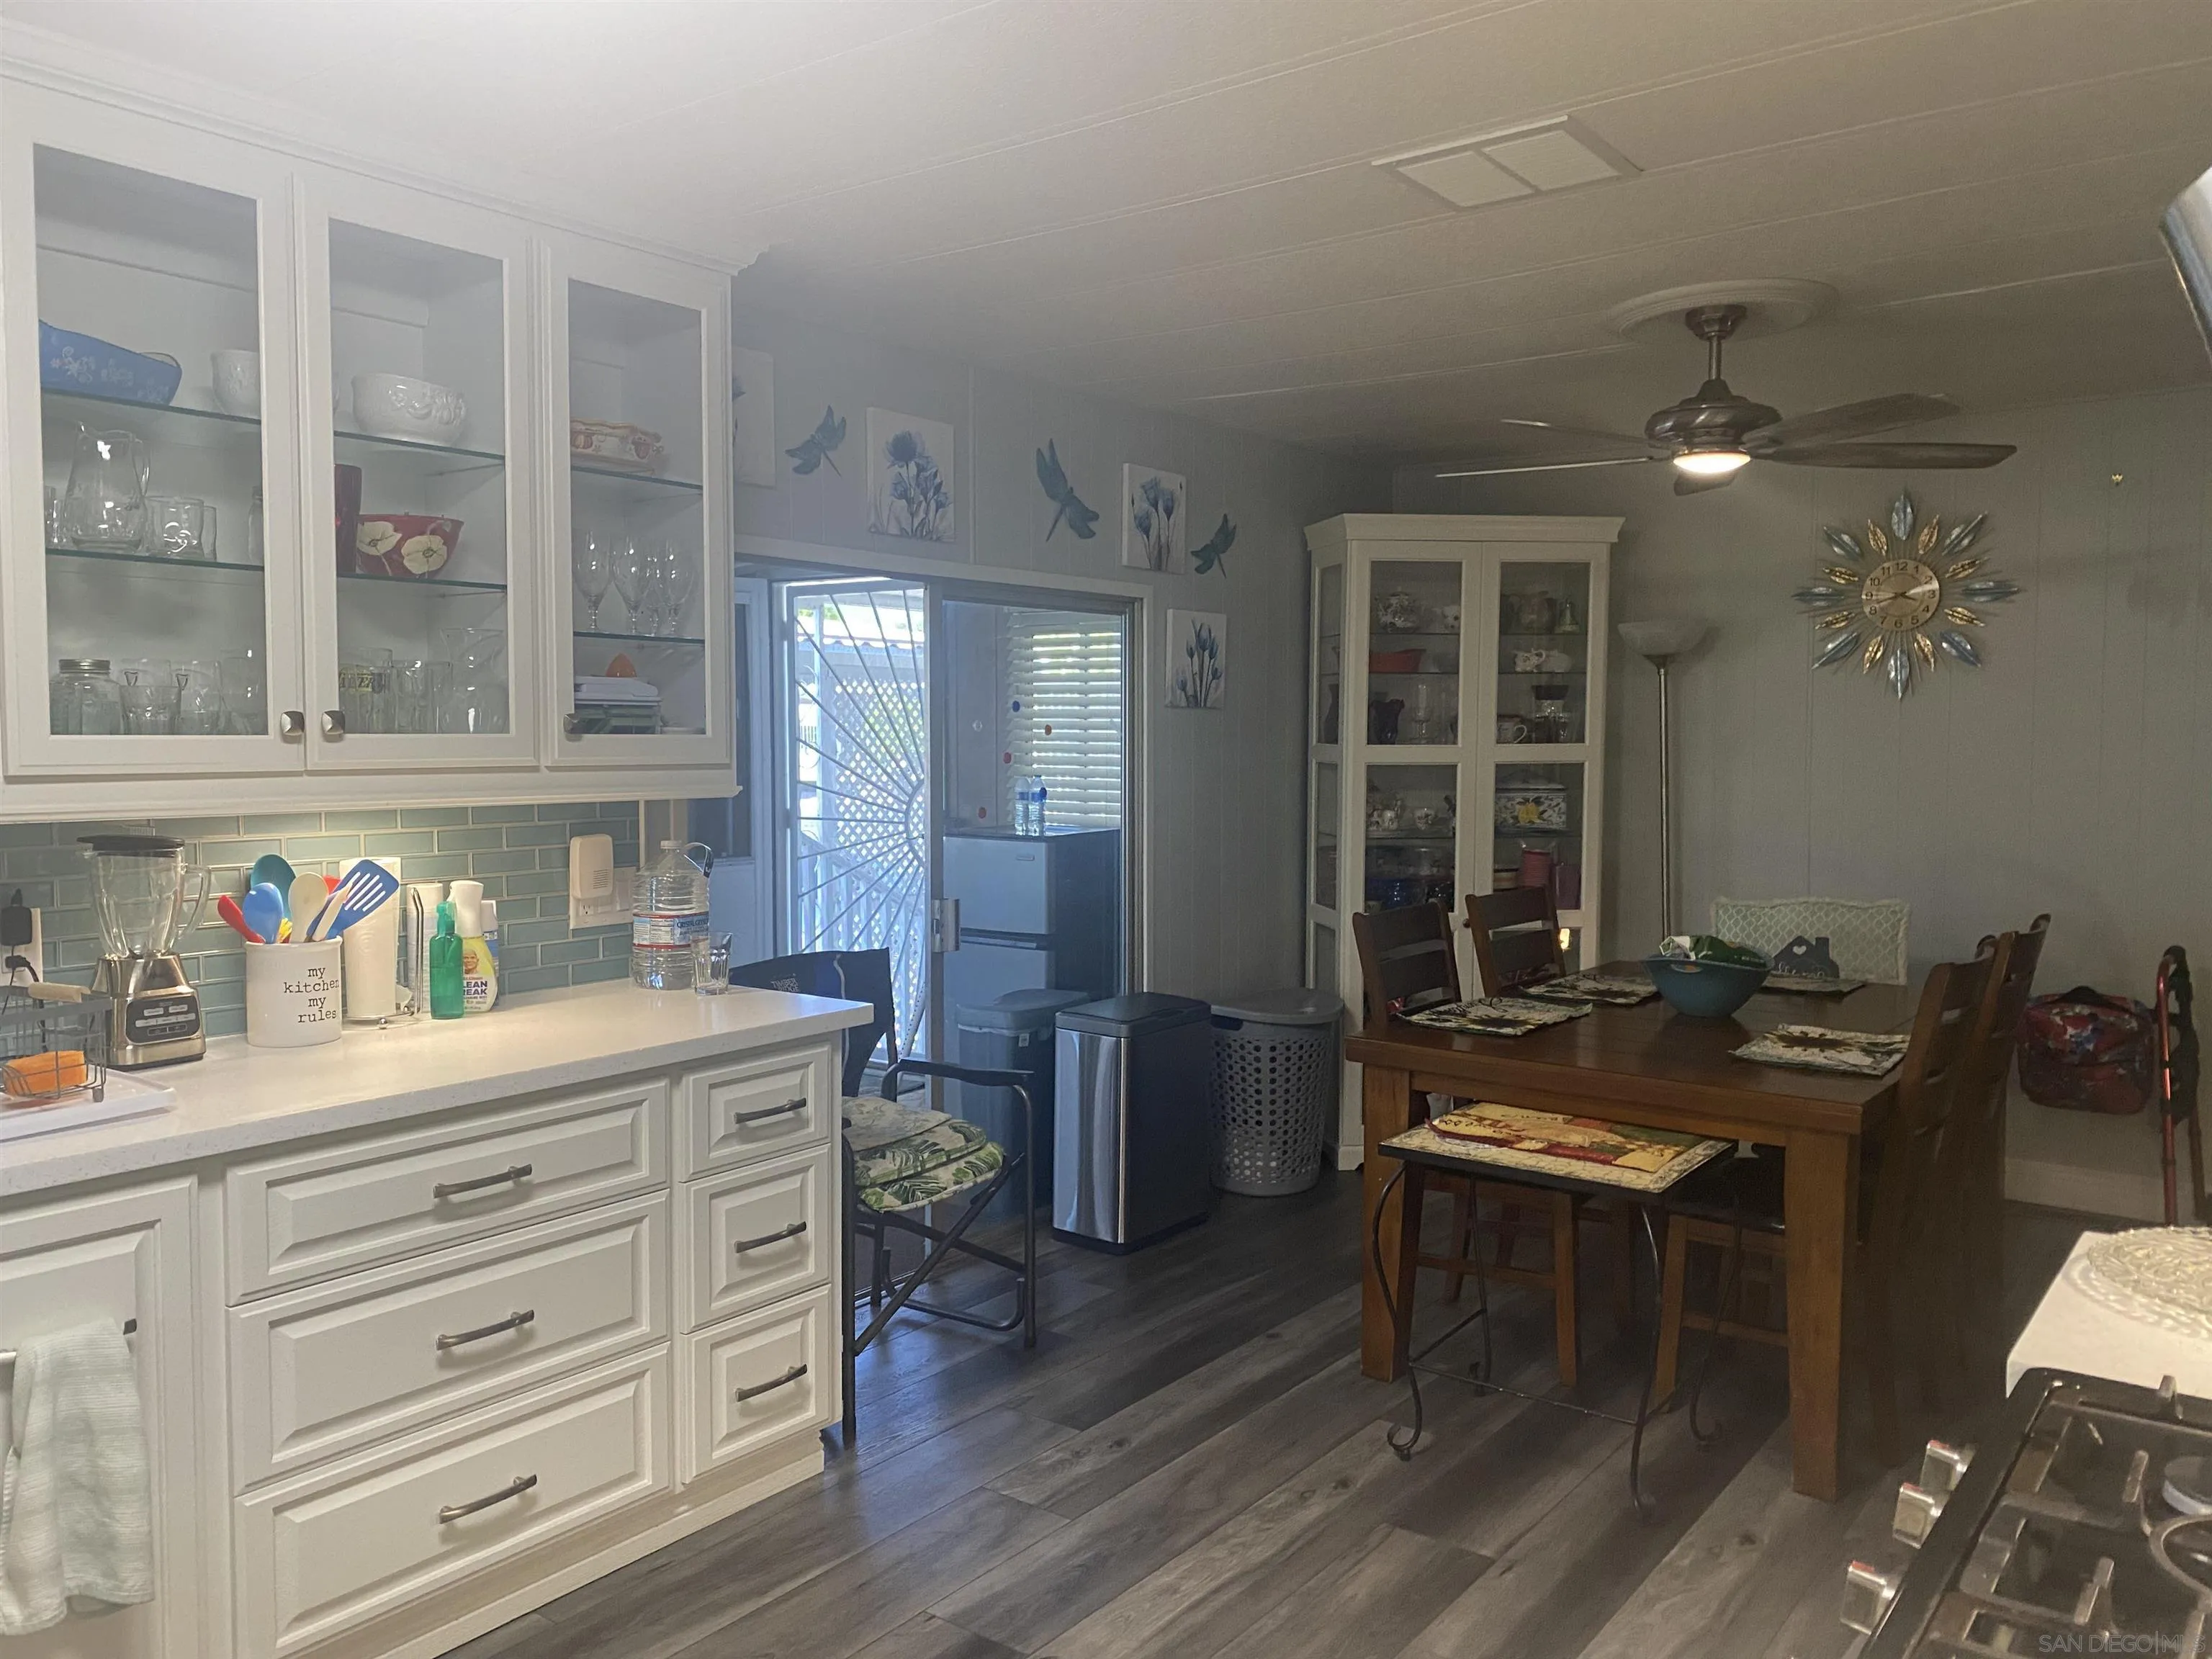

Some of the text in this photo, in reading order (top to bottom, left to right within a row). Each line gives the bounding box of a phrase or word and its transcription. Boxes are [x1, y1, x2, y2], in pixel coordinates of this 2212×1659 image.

[1881, 565, 1891, 575] 11
[1896, 562, 1908, 571] 12
[1914, 565, 1919, 575] 1
[1869, 577, 1880, 586] 10
[1924, 576, 1933, 585] 2
[1865, 591, 1874, 601] 9
[1928, 590, 1936, 599] 3
[1869, 606, 1877, 615] 8
[1880, 616, 1887, 625] 7
[1894, 619, 1902, 629] 6
[1911, 616, 1919, 625] 5
[307, 967, 326, 979] my
[283, 979, 340, 993] kitchen
[307, 997, 326, 1009] my
[297, 1010, 337, 1023] rules
